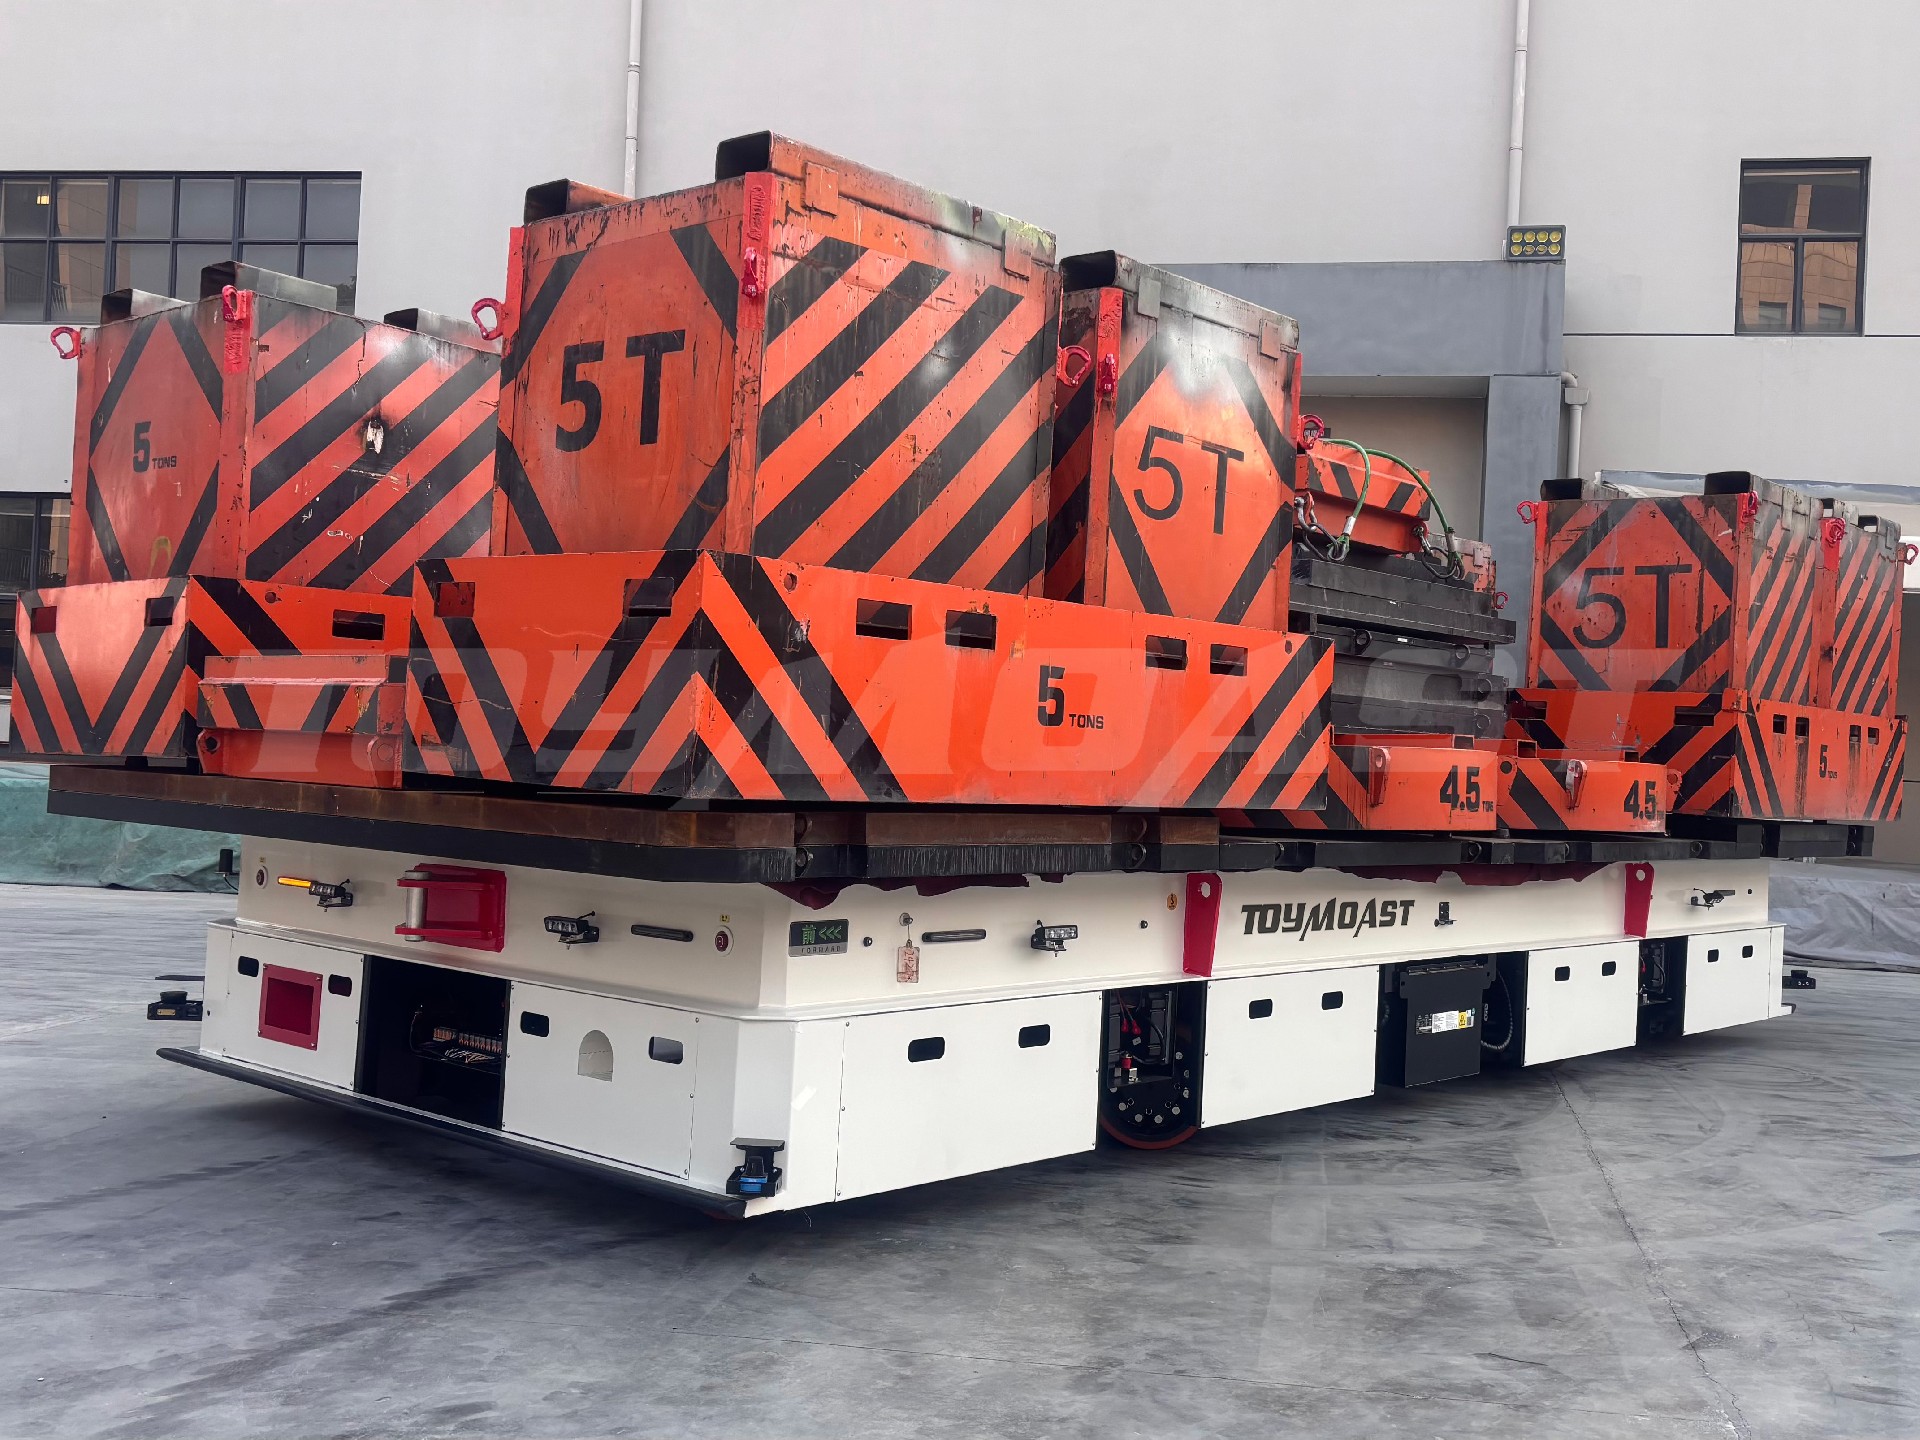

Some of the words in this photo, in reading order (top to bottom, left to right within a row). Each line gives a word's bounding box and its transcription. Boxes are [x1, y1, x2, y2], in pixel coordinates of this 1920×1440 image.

[133, 421, 151, 473] 5
[152, 456, 177, 469] TONS
[1038, 665, 1065, 726] 5
[1069, 714, 1103, 729] TONS
[1819, 744, 1828, 778] 5
[1440, 765, 1481, 812] 4.5
[1624, 780, 1656, 820] 4.5
[802, 924, 816, 945] 前
[1241, 897, 1415, 941] TOYMOAST
